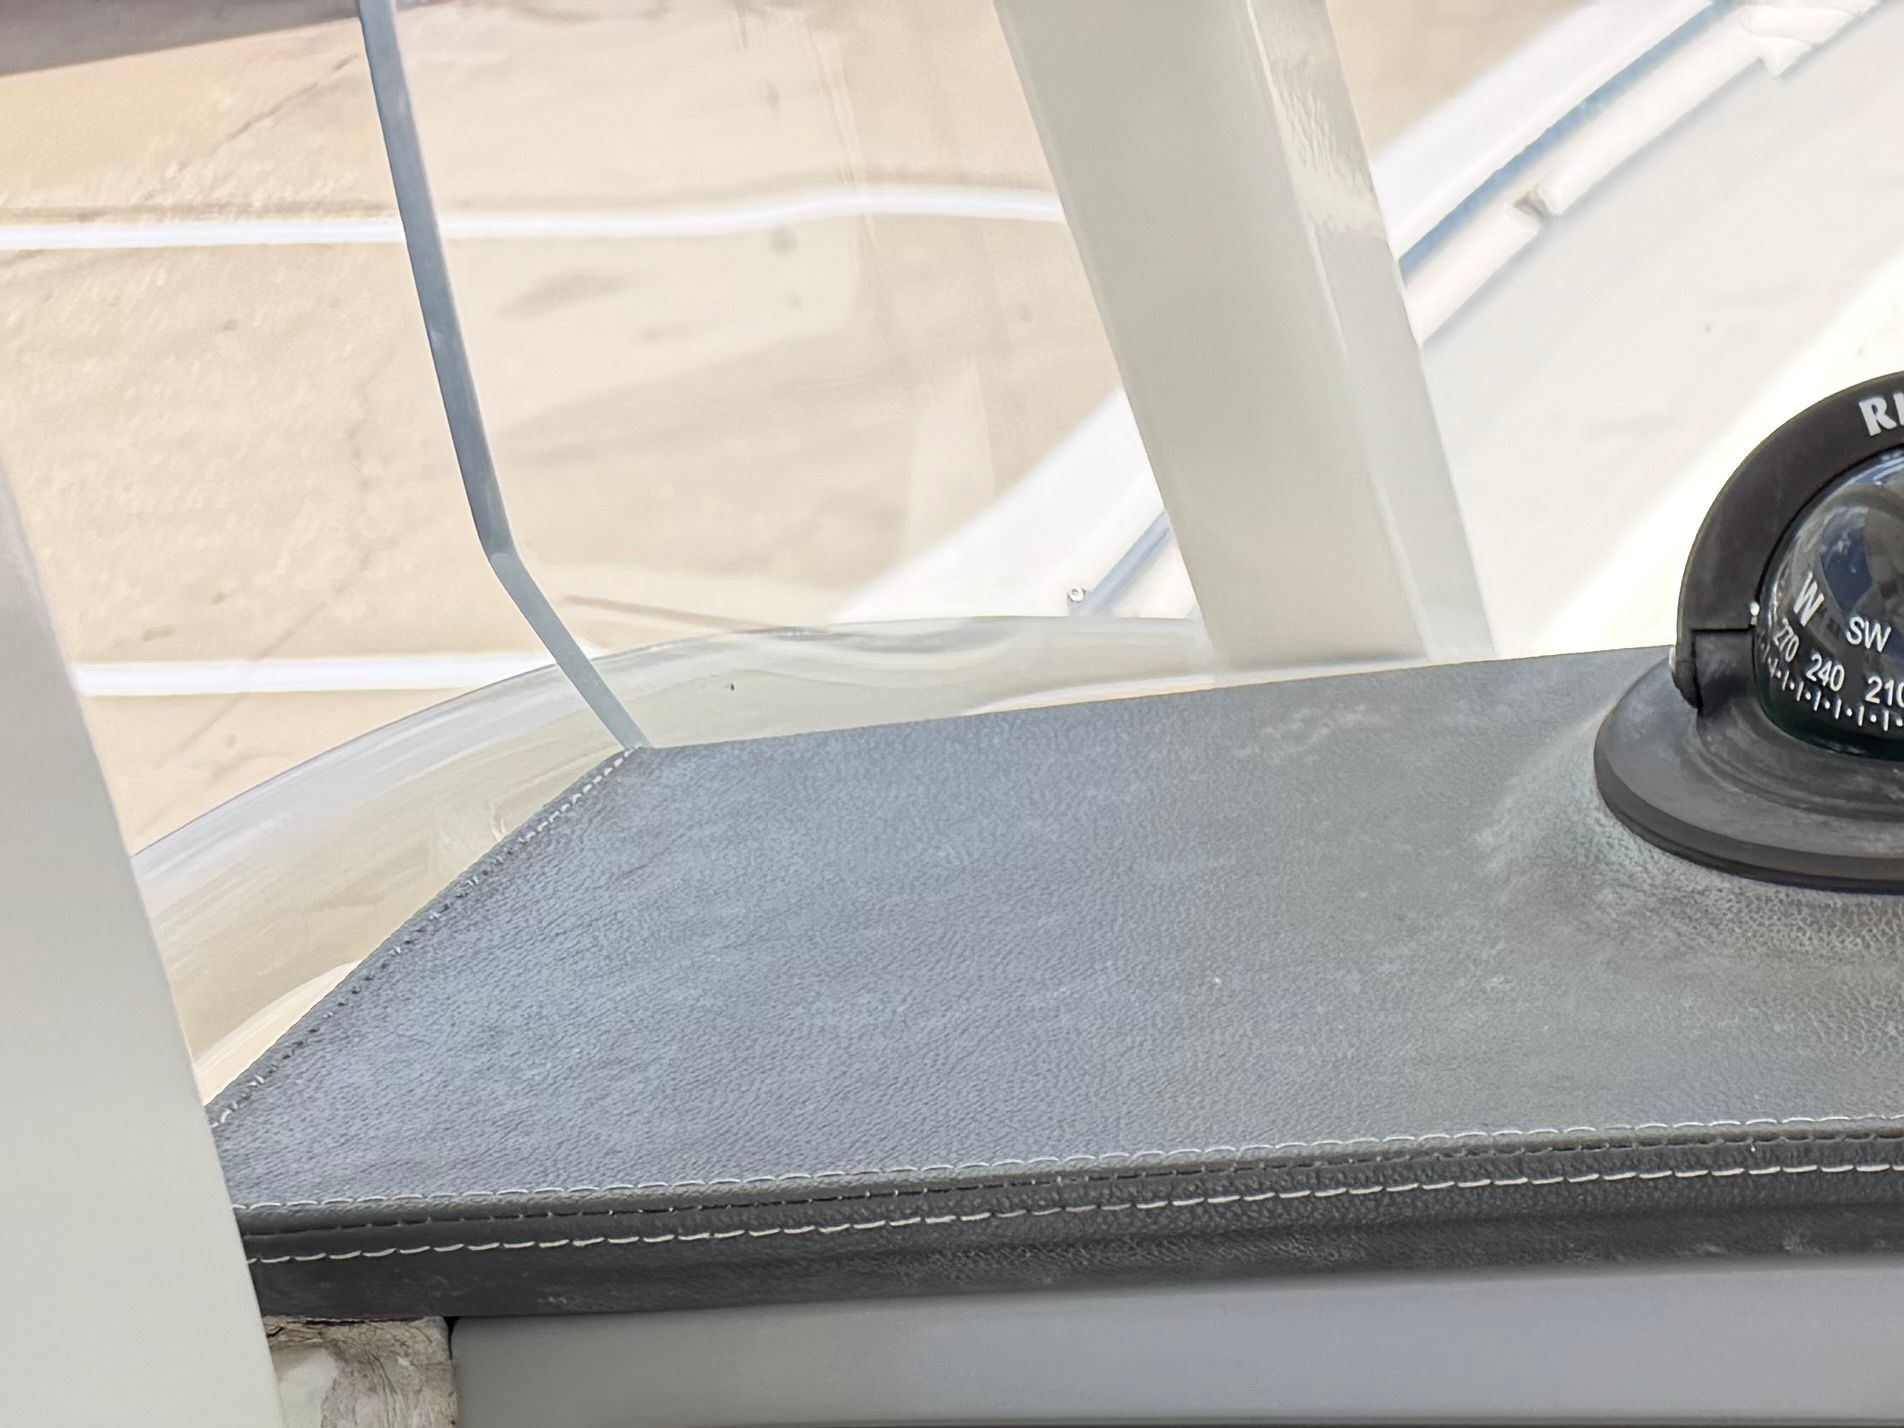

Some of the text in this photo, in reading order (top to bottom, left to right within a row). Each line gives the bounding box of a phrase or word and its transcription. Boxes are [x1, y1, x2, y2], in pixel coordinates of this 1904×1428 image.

[1793, 571, 1825, 627] W
[1773, 617, 1800, 662] 270
[1845, 616, 1892, 653] SW
[1805, 652, 1845, 692] 240
